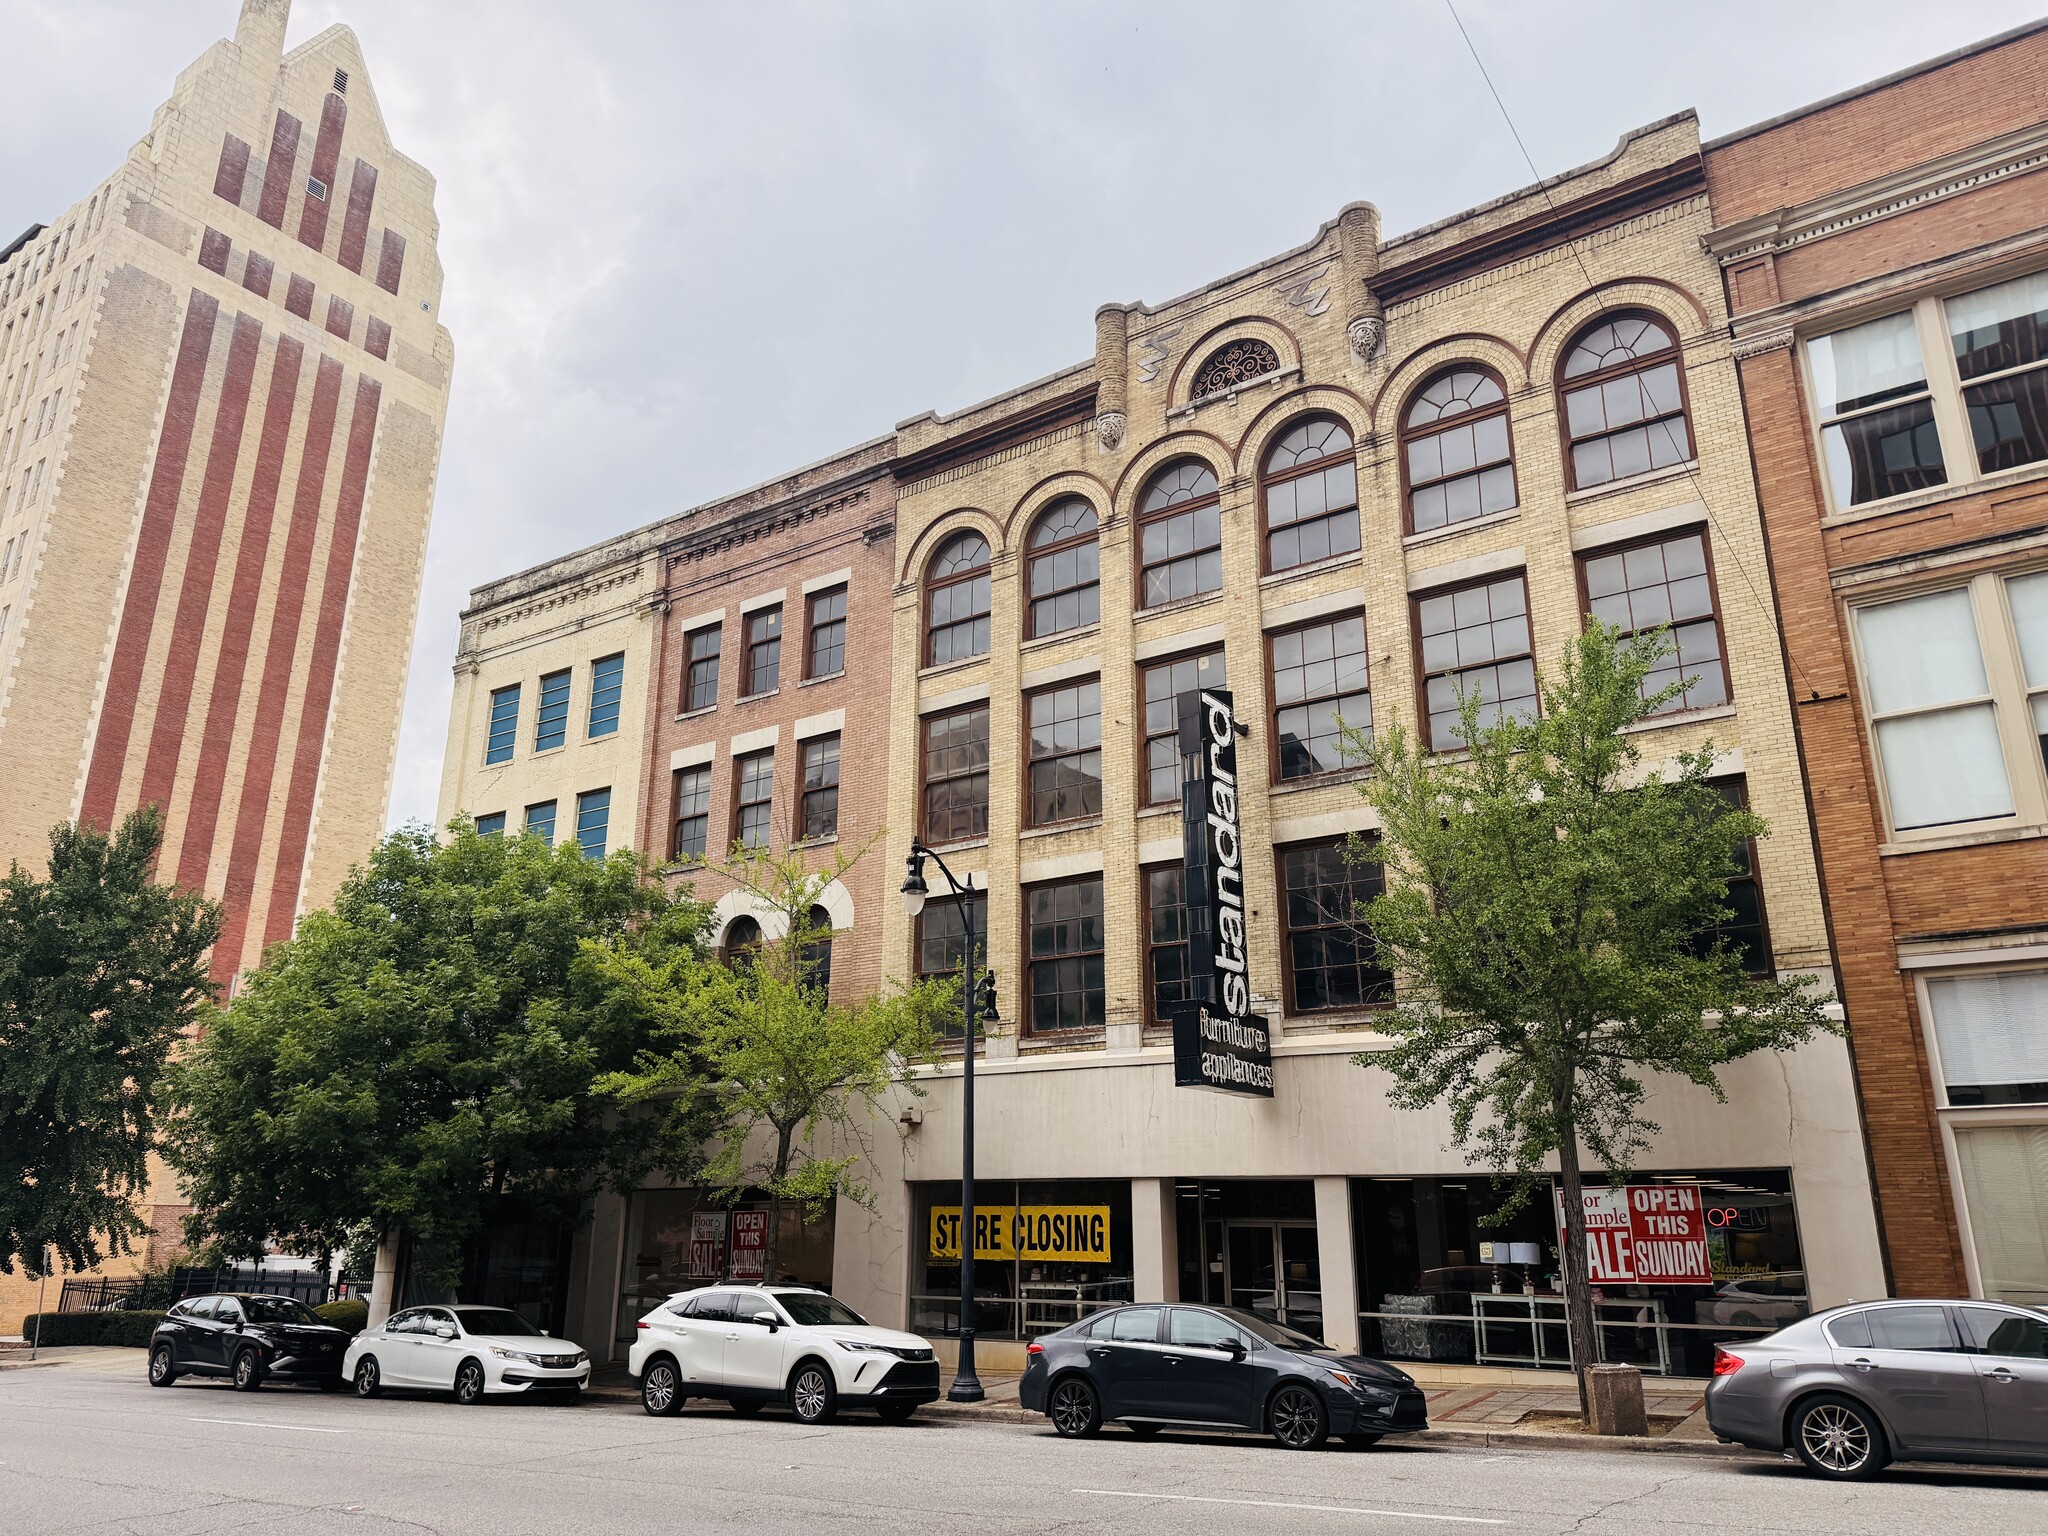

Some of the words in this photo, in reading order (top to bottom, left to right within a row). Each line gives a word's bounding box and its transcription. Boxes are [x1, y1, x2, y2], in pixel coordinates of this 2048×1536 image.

[1201, 692, 1250, 1016] standard
[1200, 1007, 1266, 1052] furniture
[1202, 1052, 1275, 1088] appliances
[1634, 1188, 1694, 1212] OPEN
[694, 1215, 714, 1227] Floor
[736, 1213, 764, 1230] OPEN
[1584, 1207, 1627, 1230] mple
[1645, 1215, 1689, 1235] THIS
[1707, 1207, 1767, 1226] OPEN
[740, 1232, 760, 1246] THIS
[936, 1213, 1002, 1250] STRE
[1012, 1213, 1104, 1252] CLOSING
[733, 1249, 765, 1275] SUNDAY
[1586, 1231, 1634, 1279] ALE
[1636, 1240, 1705, 1277] SUNDAY
[1710, 1260, 1771, 1275] Standard
